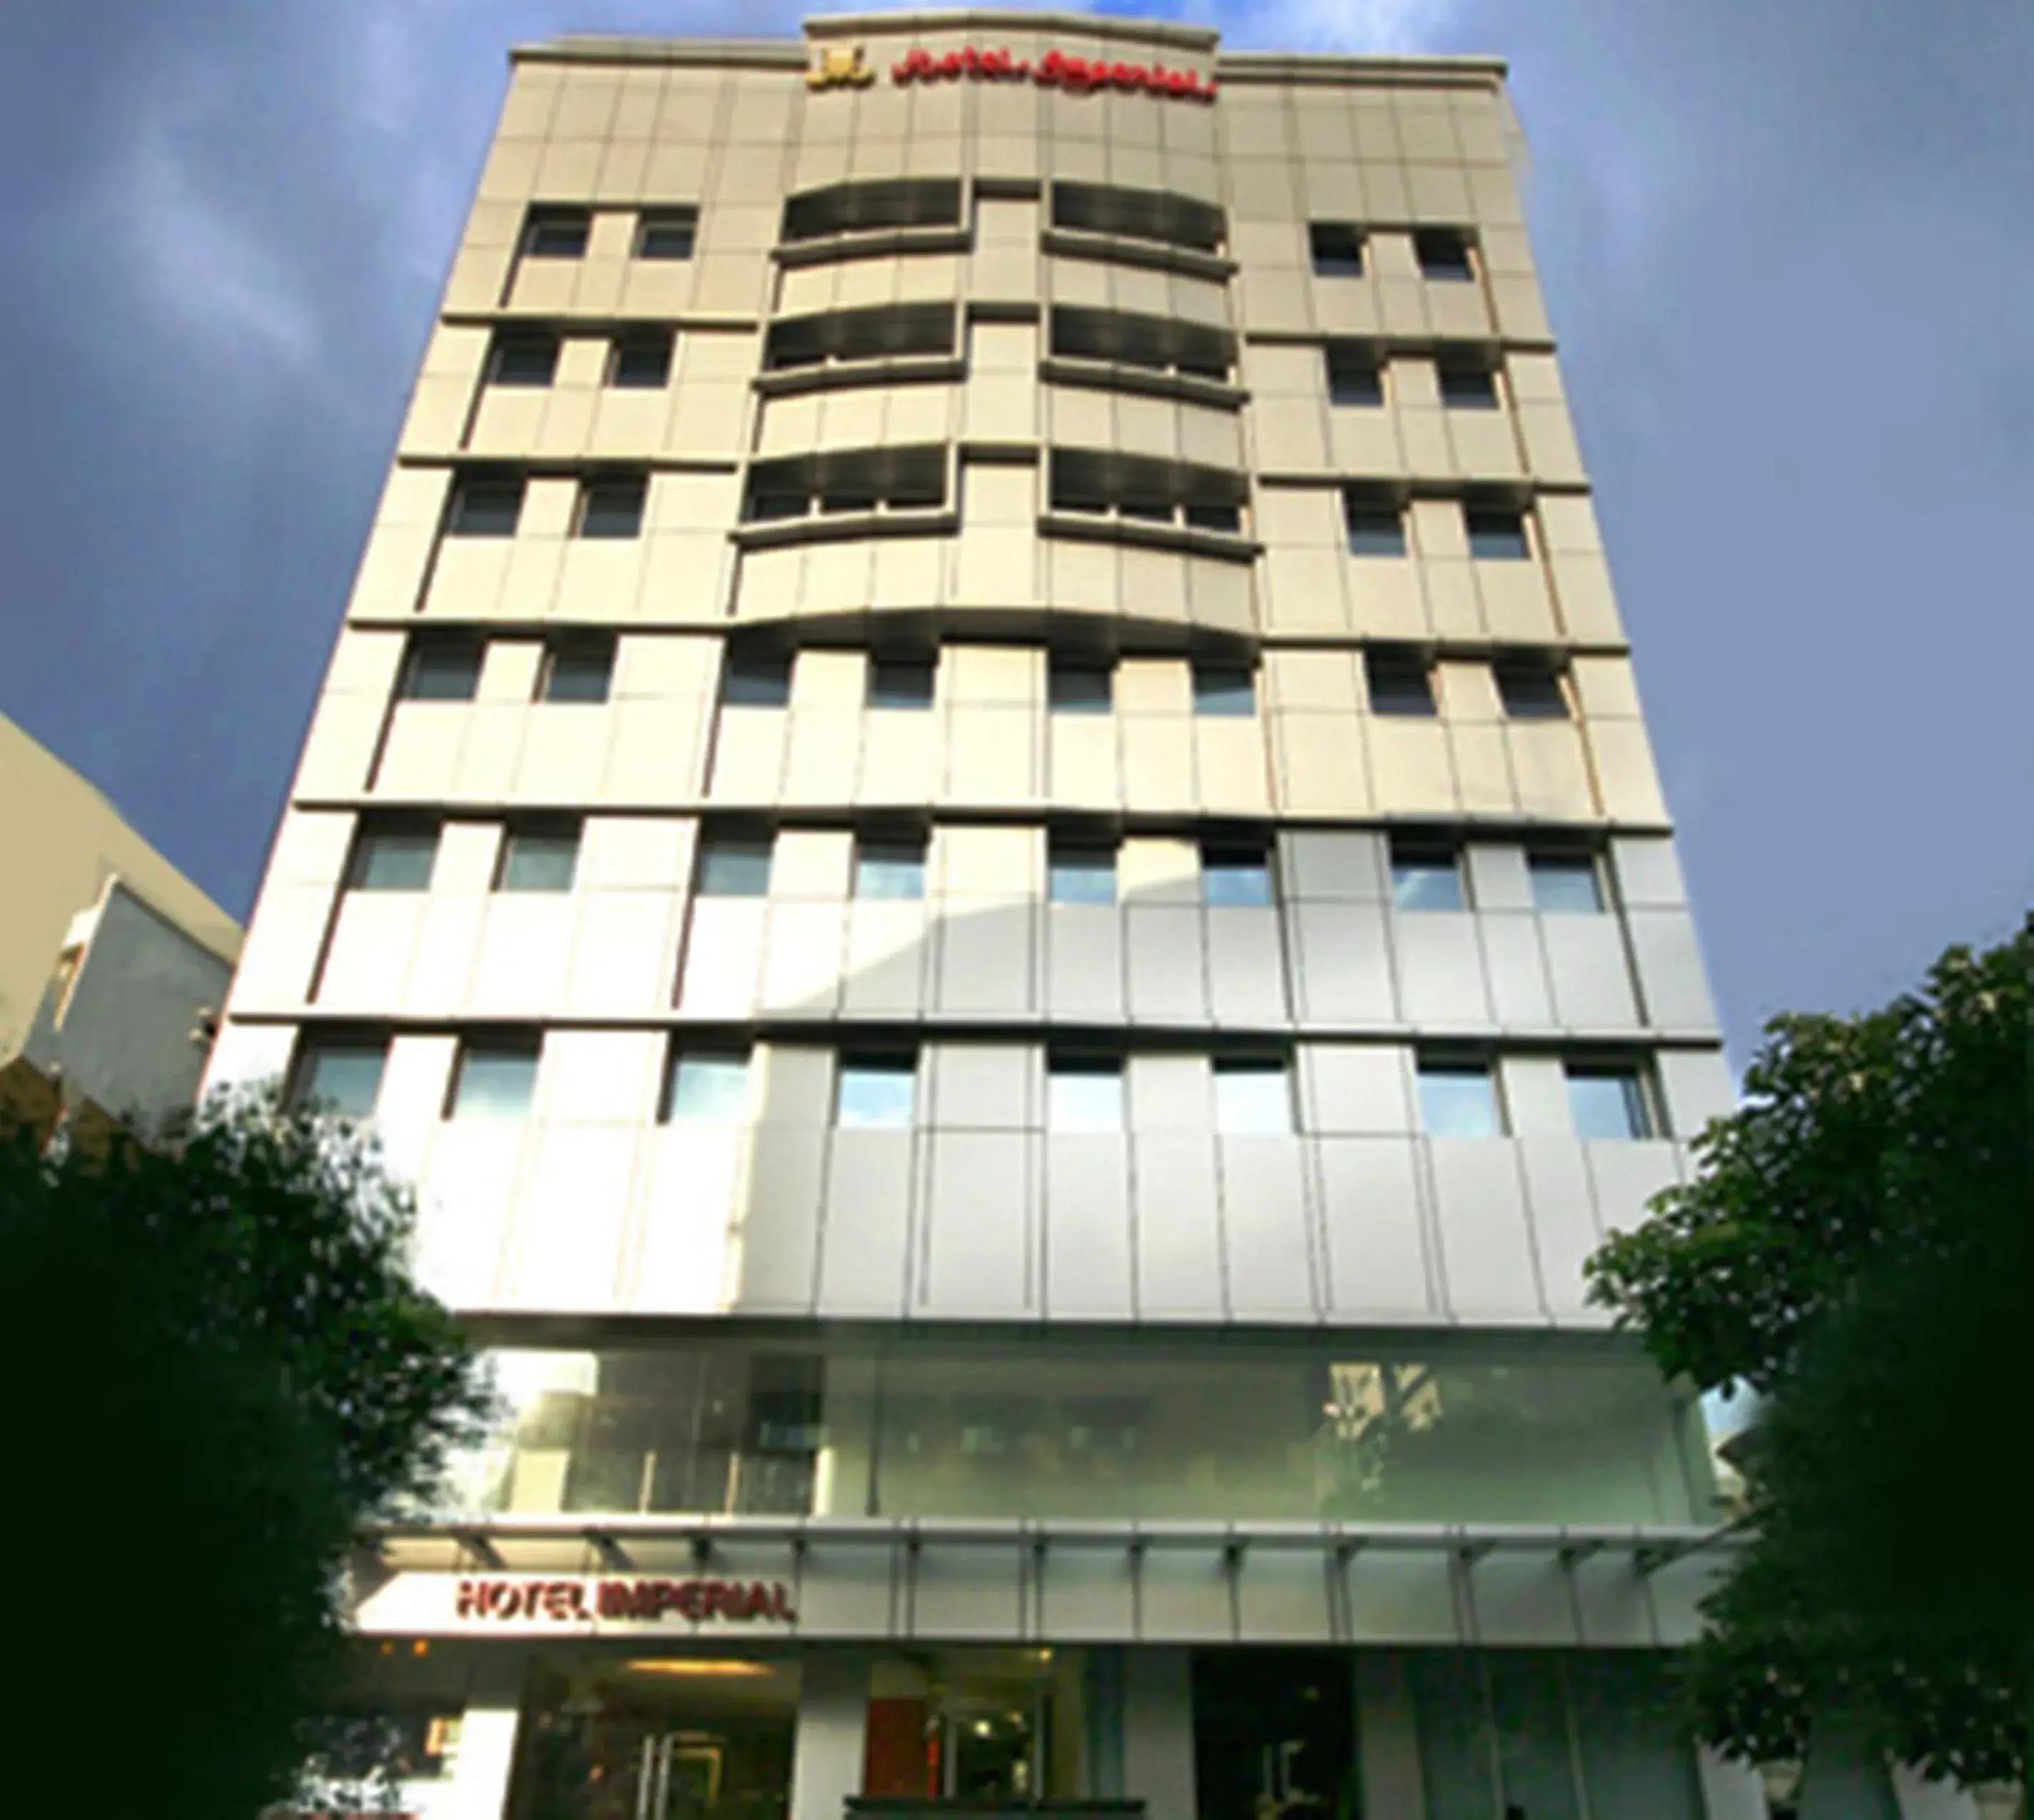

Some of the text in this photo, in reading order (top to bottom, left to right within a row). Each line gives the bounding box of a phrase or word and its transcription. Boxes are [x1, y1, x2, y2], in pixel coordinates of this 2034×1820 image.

[892, 44, 1029, 87] Hotel
[457, 1580, 798, 1622] HOTEL IMPERIAL
